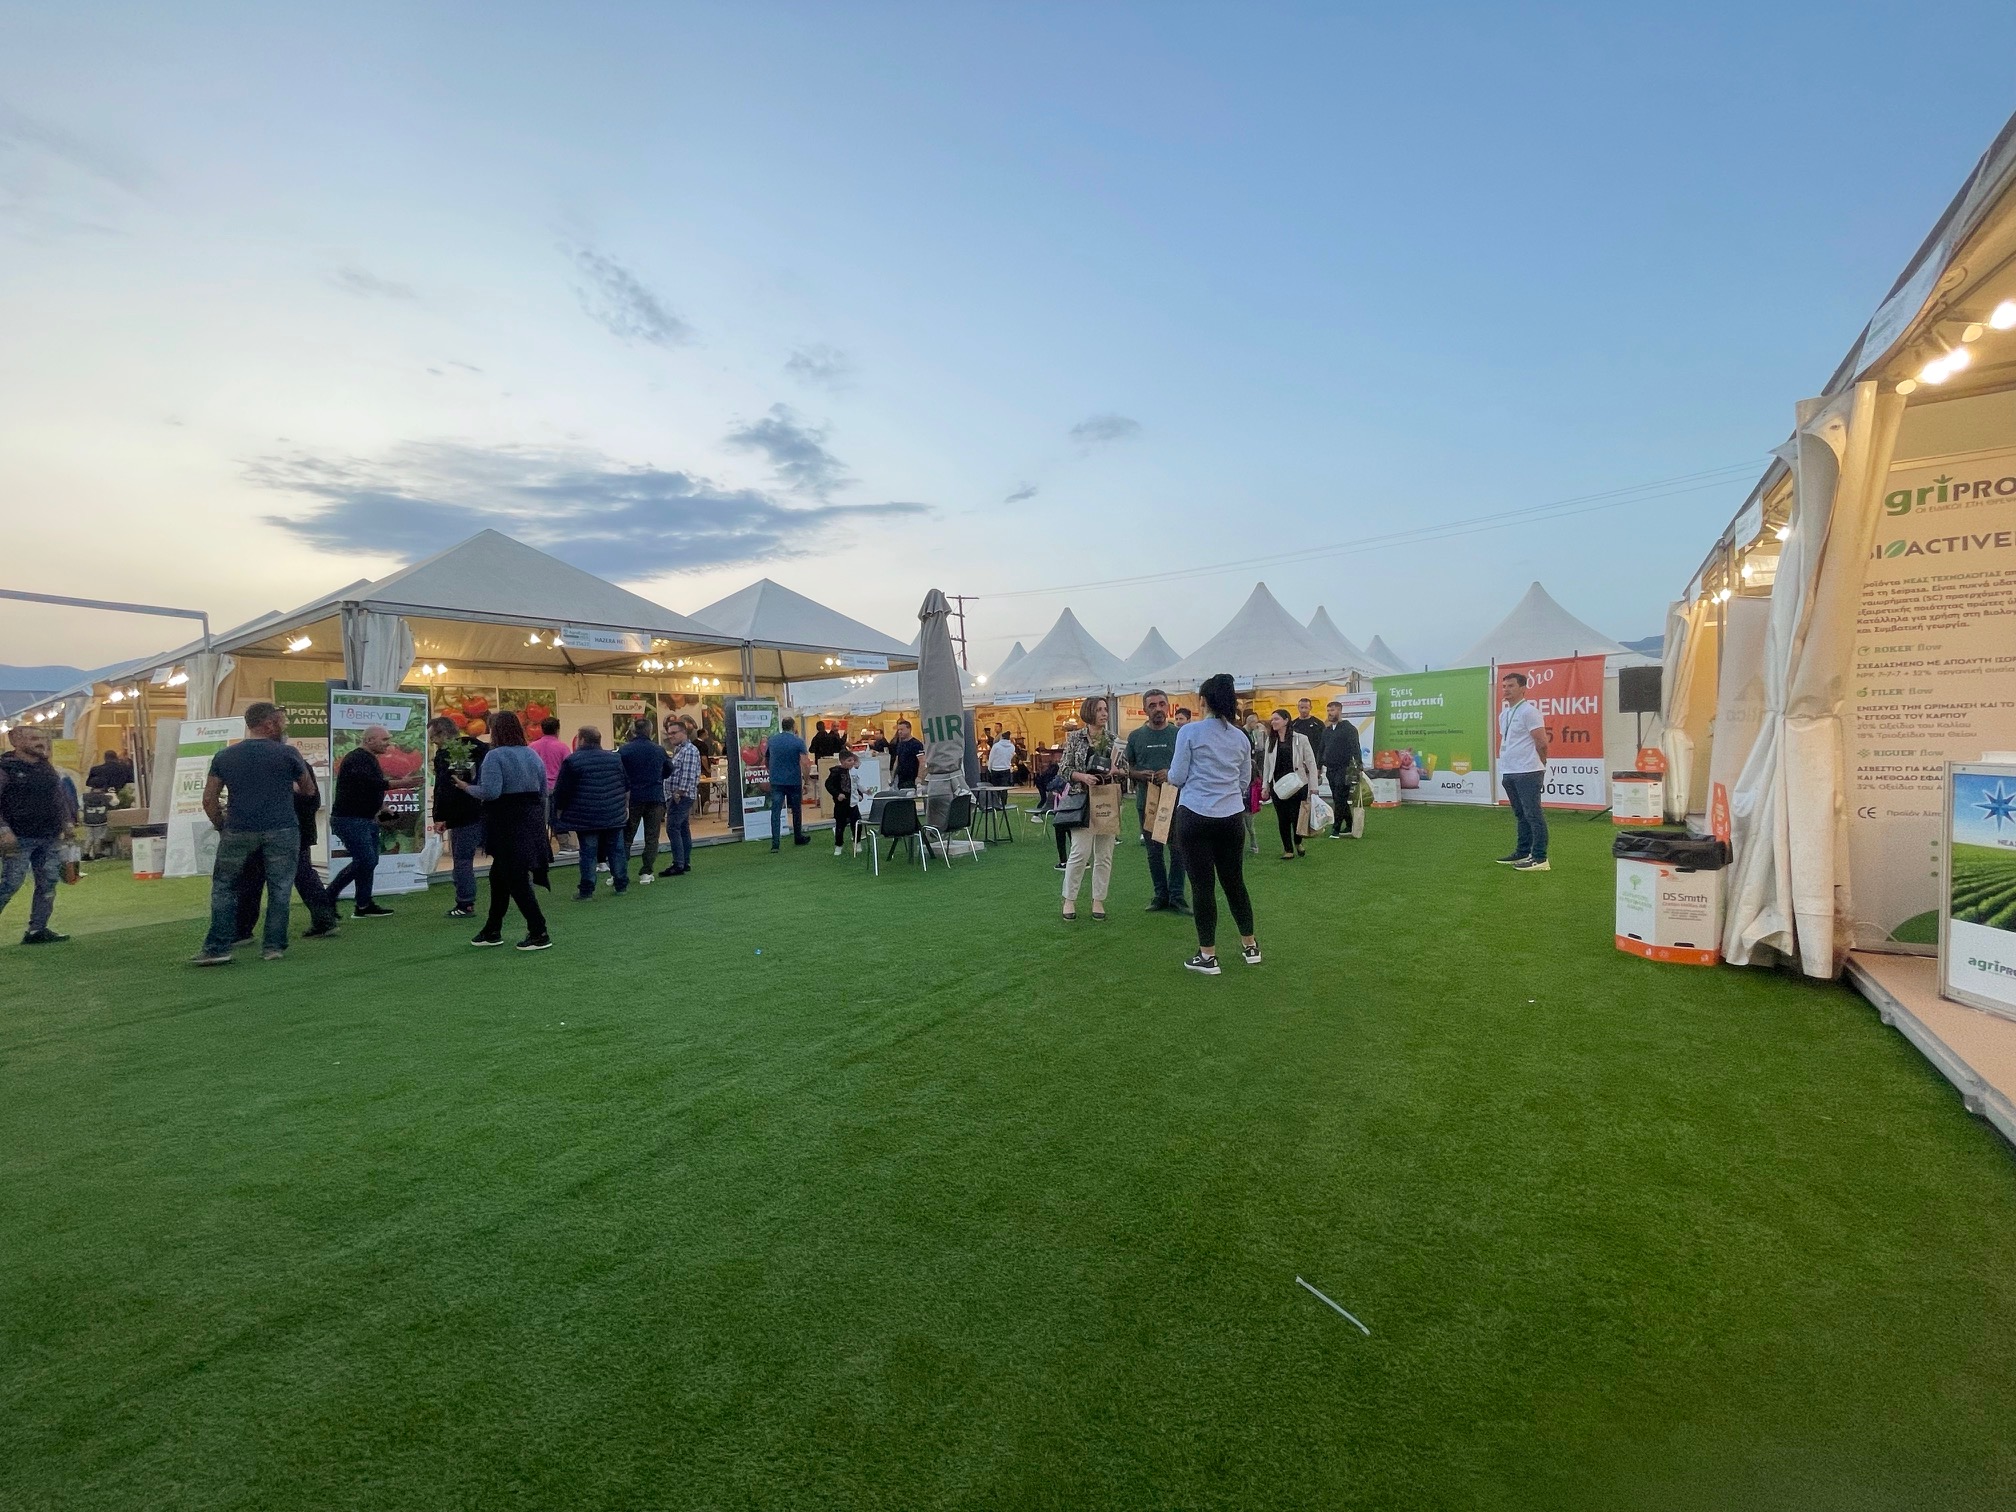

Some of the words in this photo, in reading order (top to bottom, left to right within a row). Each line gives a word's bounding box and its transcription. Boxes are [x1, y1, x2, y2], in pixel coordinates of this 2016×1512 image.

[1863, 580, 1901, 589] ροϊόντα
[1861, 597, 1920, 606] ναιωρήματα
[1874, 624, 1923, 633] Συμβατική
[1526, 668, 1554, 689] διο
[1390, 687, 1412, 698] Έχεις
[1391, 694, 1444, 708] πιστωτική
[1391, 709, 1423, 721] κάρτα;
[1561, 726, 1590, 743] fm
[745, 770, 769, 778] ΠΡΟΣΤΑ
[1550, 765, 1567, 776] για
[1572, 766, 1599, 775] τους
[1540, 778, 1585, 796] ότες
[383, 794, 419, 802] ΑΣΙΑΣ
[388, 804, 419, 812] ΟΣΗΣ
[1663, 893, 1676, 901] DS
[1678, 893, 1708, 903] Smith
